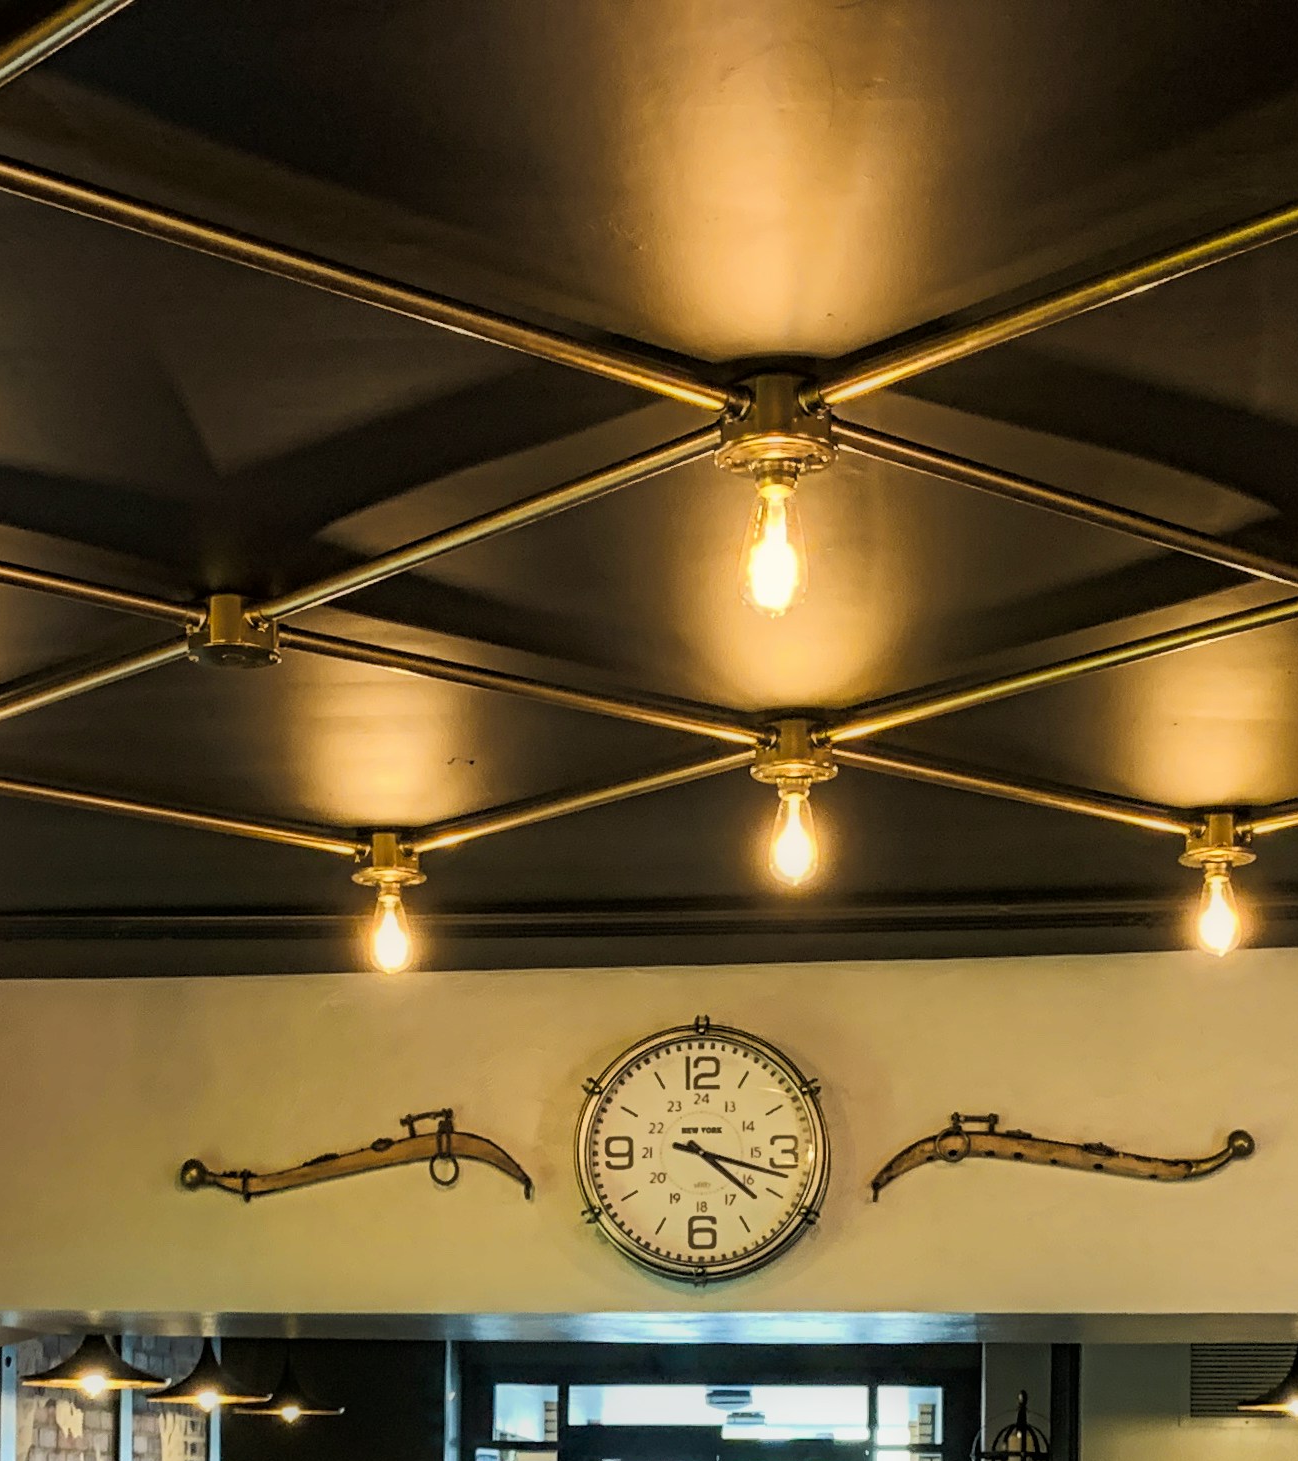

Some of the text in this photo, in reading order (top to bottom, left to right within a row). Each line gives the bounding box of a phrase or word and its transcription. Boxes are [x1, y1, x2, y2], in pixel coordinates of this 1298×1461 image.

[685, 1055, 721, 1090] 12
[693, 1093, 710, 1105] 24
[667, 1100, 682, 1113] 23
[724, 1100, 736, 1113] 13
[648, 1122, 664, 1134] 22
[701, 1126, 723, 1134] YORK
[742, 1120, 755, 1132] 14
[604, 1135, 634, 1171] 9
[641, 1146, 653, 1159] 21
[750, 1146, 762, 1159] 15
[769, 1134, 799, 1169] 3
[649, 1171, 667, 1184] 20
[742, 1173, 755, 1186] 16
[669, 1192, 681, 1205] 19
[725, 1193, 737, 1206] 17
[696, 1201, 708, 1213] 18
[687, 1215, 718, 1250] 6
